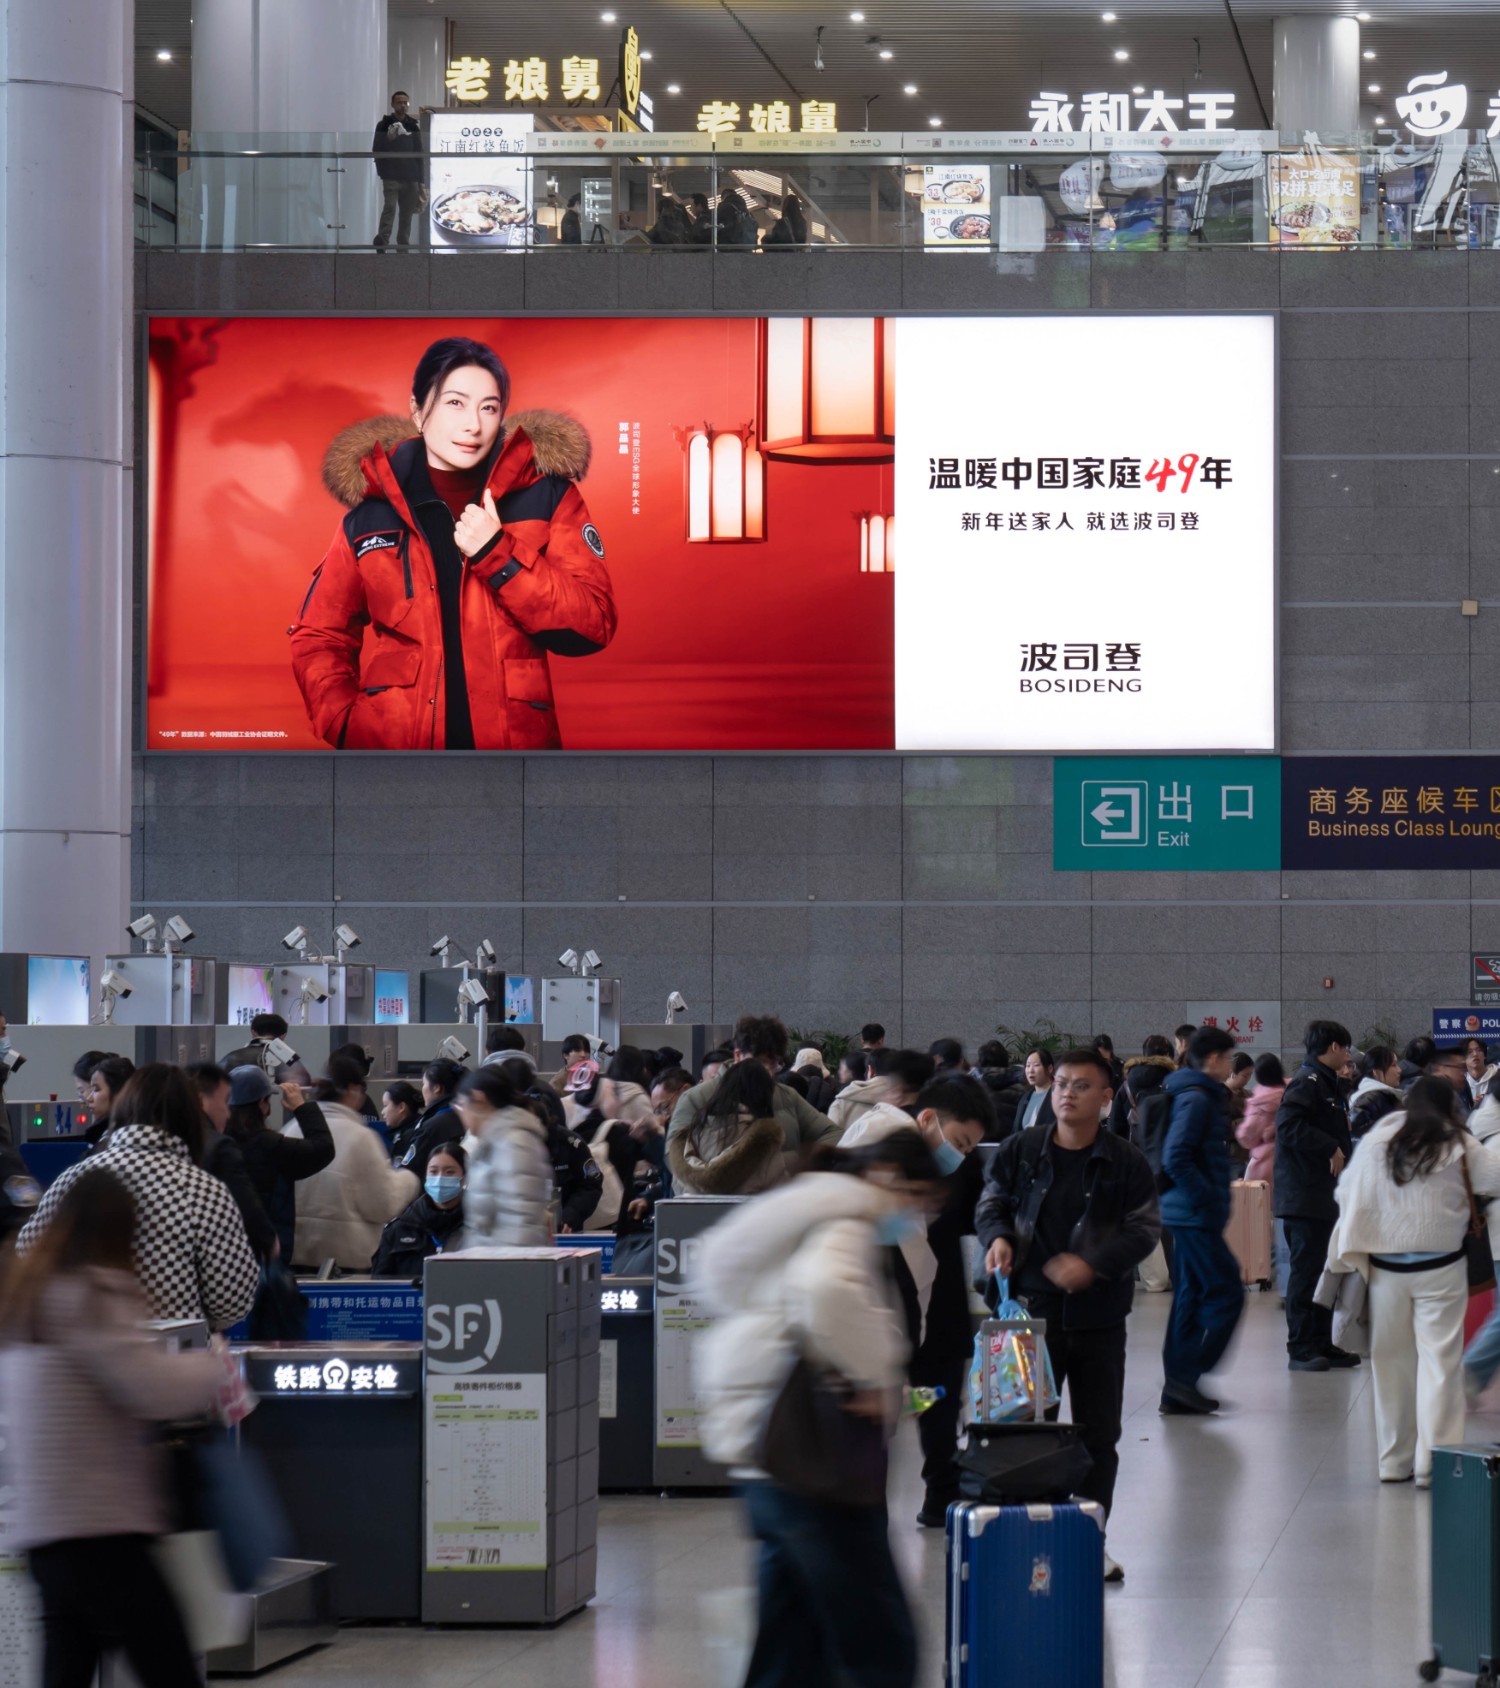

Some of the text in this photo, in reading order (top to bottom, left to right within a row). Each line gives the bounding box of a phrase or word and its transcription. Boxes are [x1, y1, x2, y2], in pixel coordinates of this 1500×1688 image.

[446, 56, 599, 100] 老娘舅
[1029, 90, 1235, 132] 永和大王
[929, 453, 1233, 493] 温暖中国家庭49年
[961, 511, 1199, 531] 新年送家人 就选波司登
[1020, 642, 1141, 672] 波司登
[1020, 679, 1142, 693] BOSIDENG
[1159, 782, 1253, 821] 出口
[1158, 832, 1189, 846] Exit
[1309, 820, 1389, 837] Business
[1395, 820, 1444, 837] Class
[1439, 1018, 1461, 1029] 警察
[274, 1363, 399, 1390] 铁路 安检
